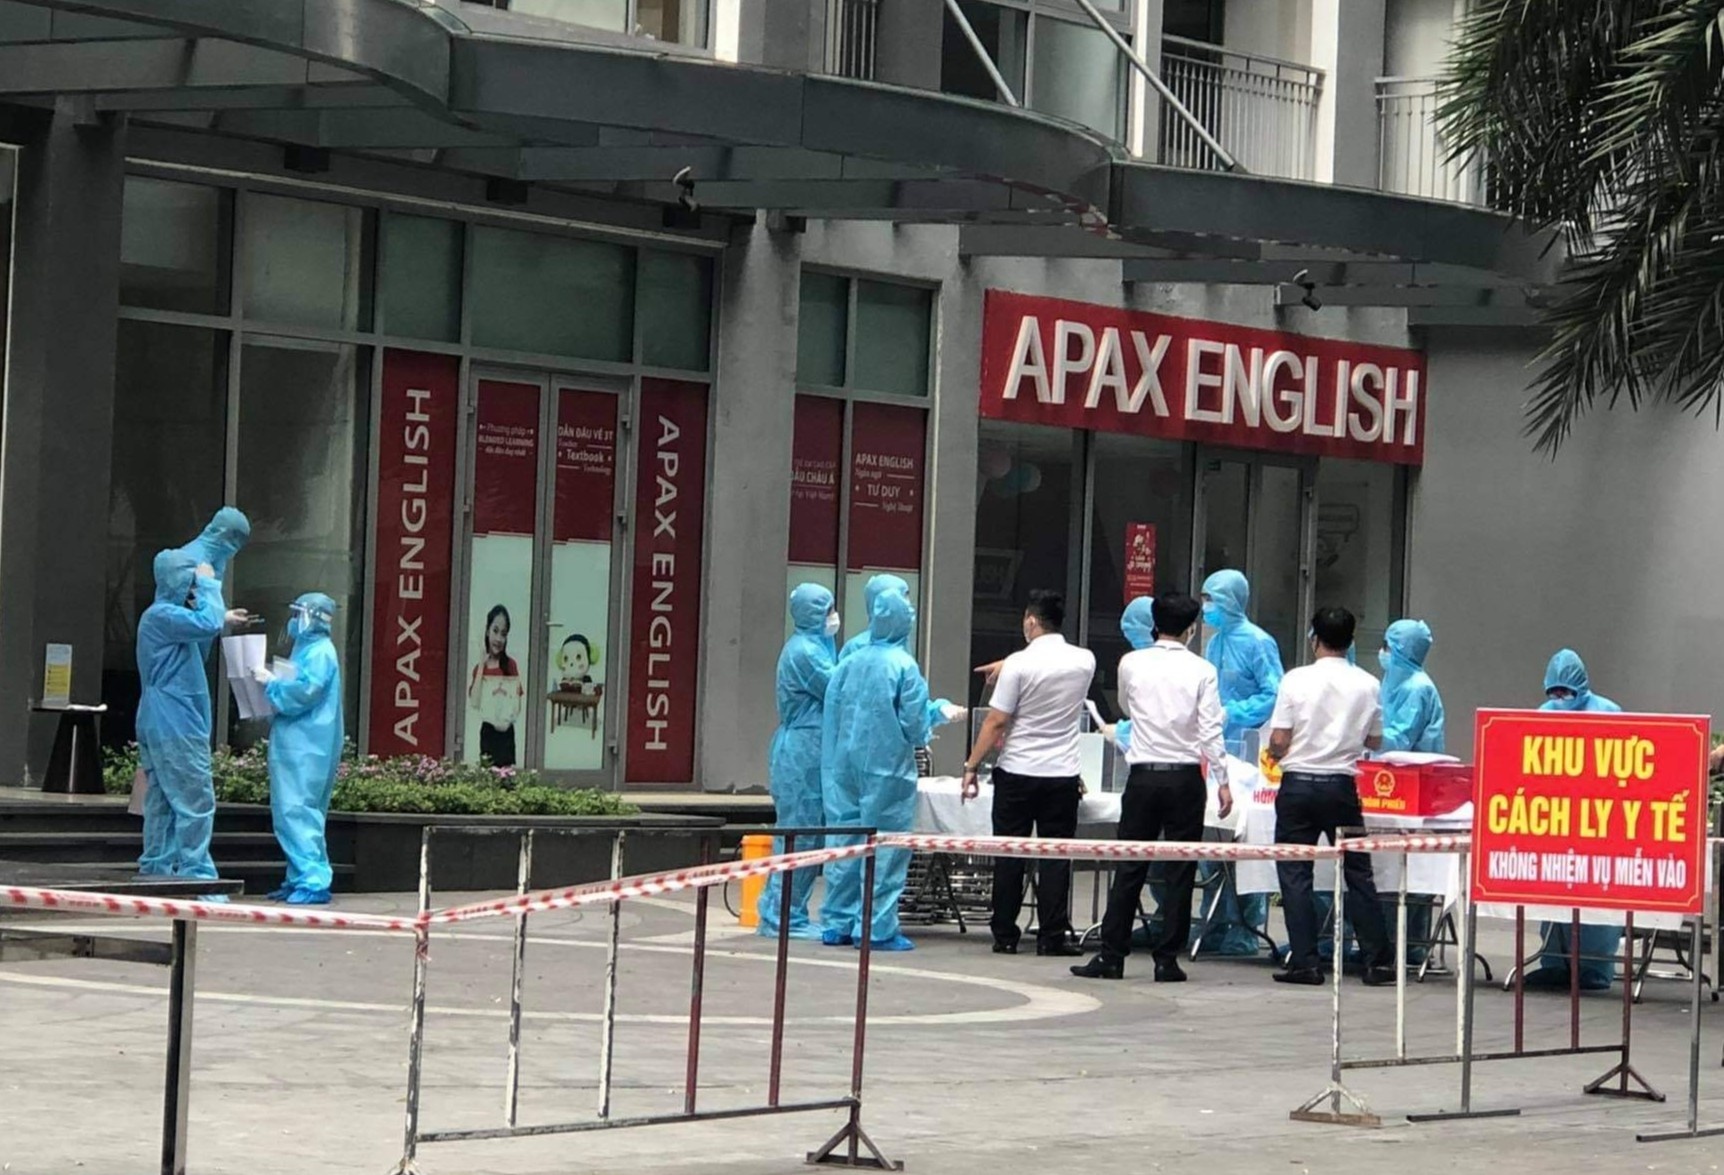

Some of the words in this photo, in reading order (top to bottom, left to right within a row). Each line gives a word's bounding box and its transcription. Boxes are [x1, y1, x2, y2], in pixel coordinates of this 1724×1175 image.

[1003, 316, 1172, 416] APAX
[1184, 338, 1418, 445] ENGLISH
[566, 449, 604, 462] Textbook
[654, 415, 680, 538] APAX
[856, 453, 877, 466] APAX
[879, 455, 914, 469] ENGLISH
[399, 389, 430, 599] ENGLISH
[881, 485, 901, 498] DUY
[645, 553, 675, 750] ENGLISH
[394, 616, 423, 745] APAX
[1522, 735, 1585, 777] KHU
[1594, 735, 1655, 787] VỰC
[1488, 787, 1570, 837] CÁCH
[1579, 798, 1613, 838] LY
[1623, 800, 1642, 839] Y
[1650, 790, 1690, 842] TẾ
[1489, 846, 1538, 880] KHÔNG
[1541, 848, 1588, 889] NHIỆM
[1592, 856, 1610, 891] VỤ
[1657, 853, 1686, 889] VÀO
